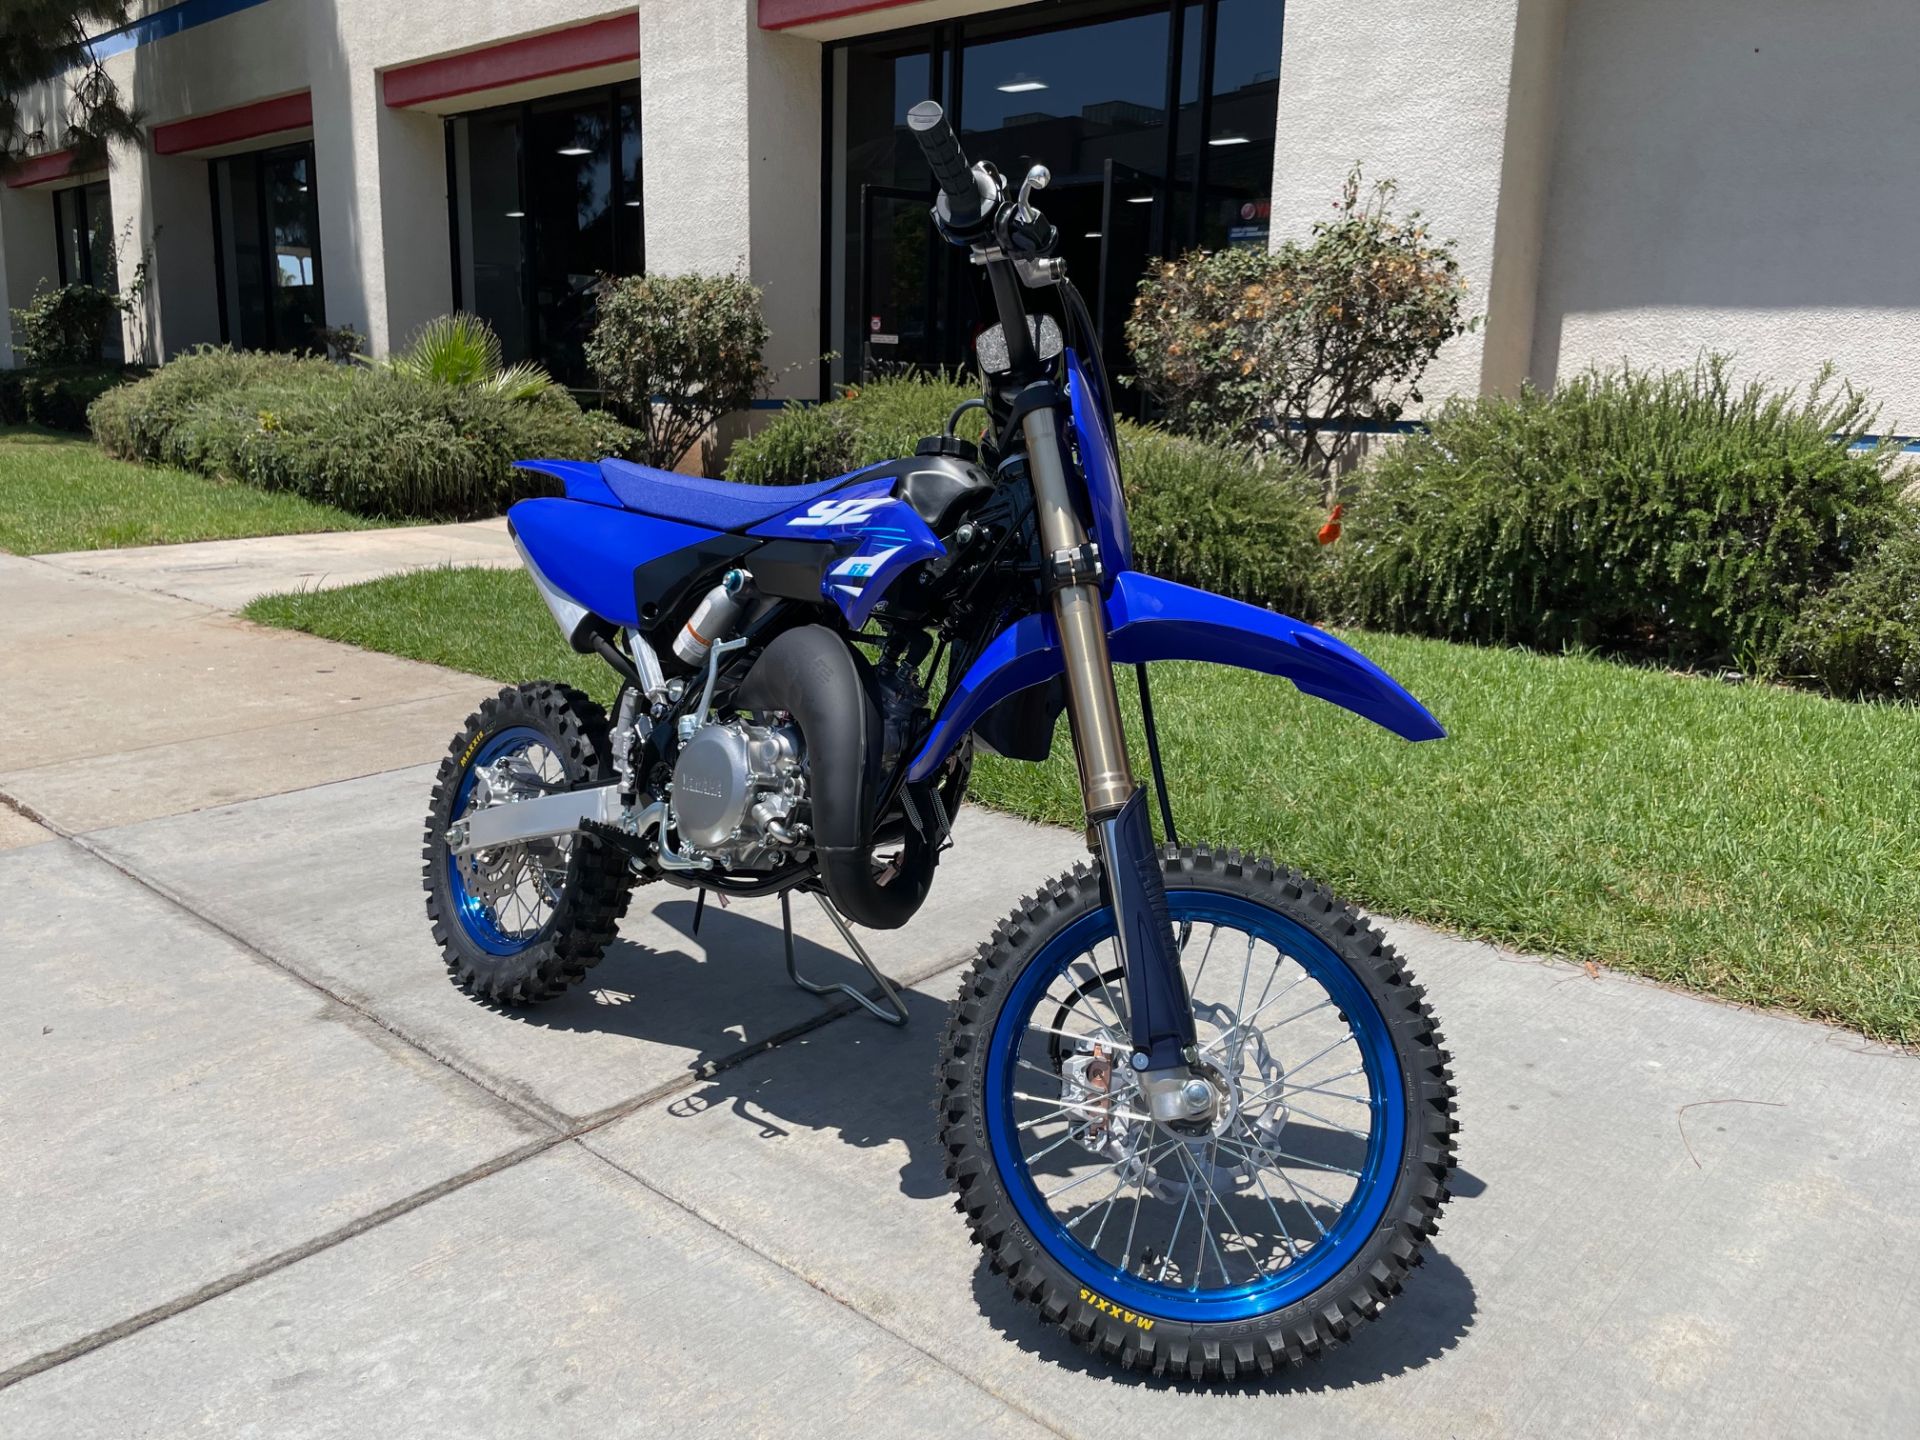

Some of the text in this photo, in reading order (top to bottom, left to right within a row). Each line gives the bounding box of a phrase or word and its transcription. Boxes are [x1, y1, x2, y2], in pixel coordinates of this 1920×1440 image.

[786, 497, 896, 526] YZ
[847, 563, 872, 576] 65
[459, 731, 485, 768] MAXXIS
[1080, 1288, 1155, 1331] MAXXIS
